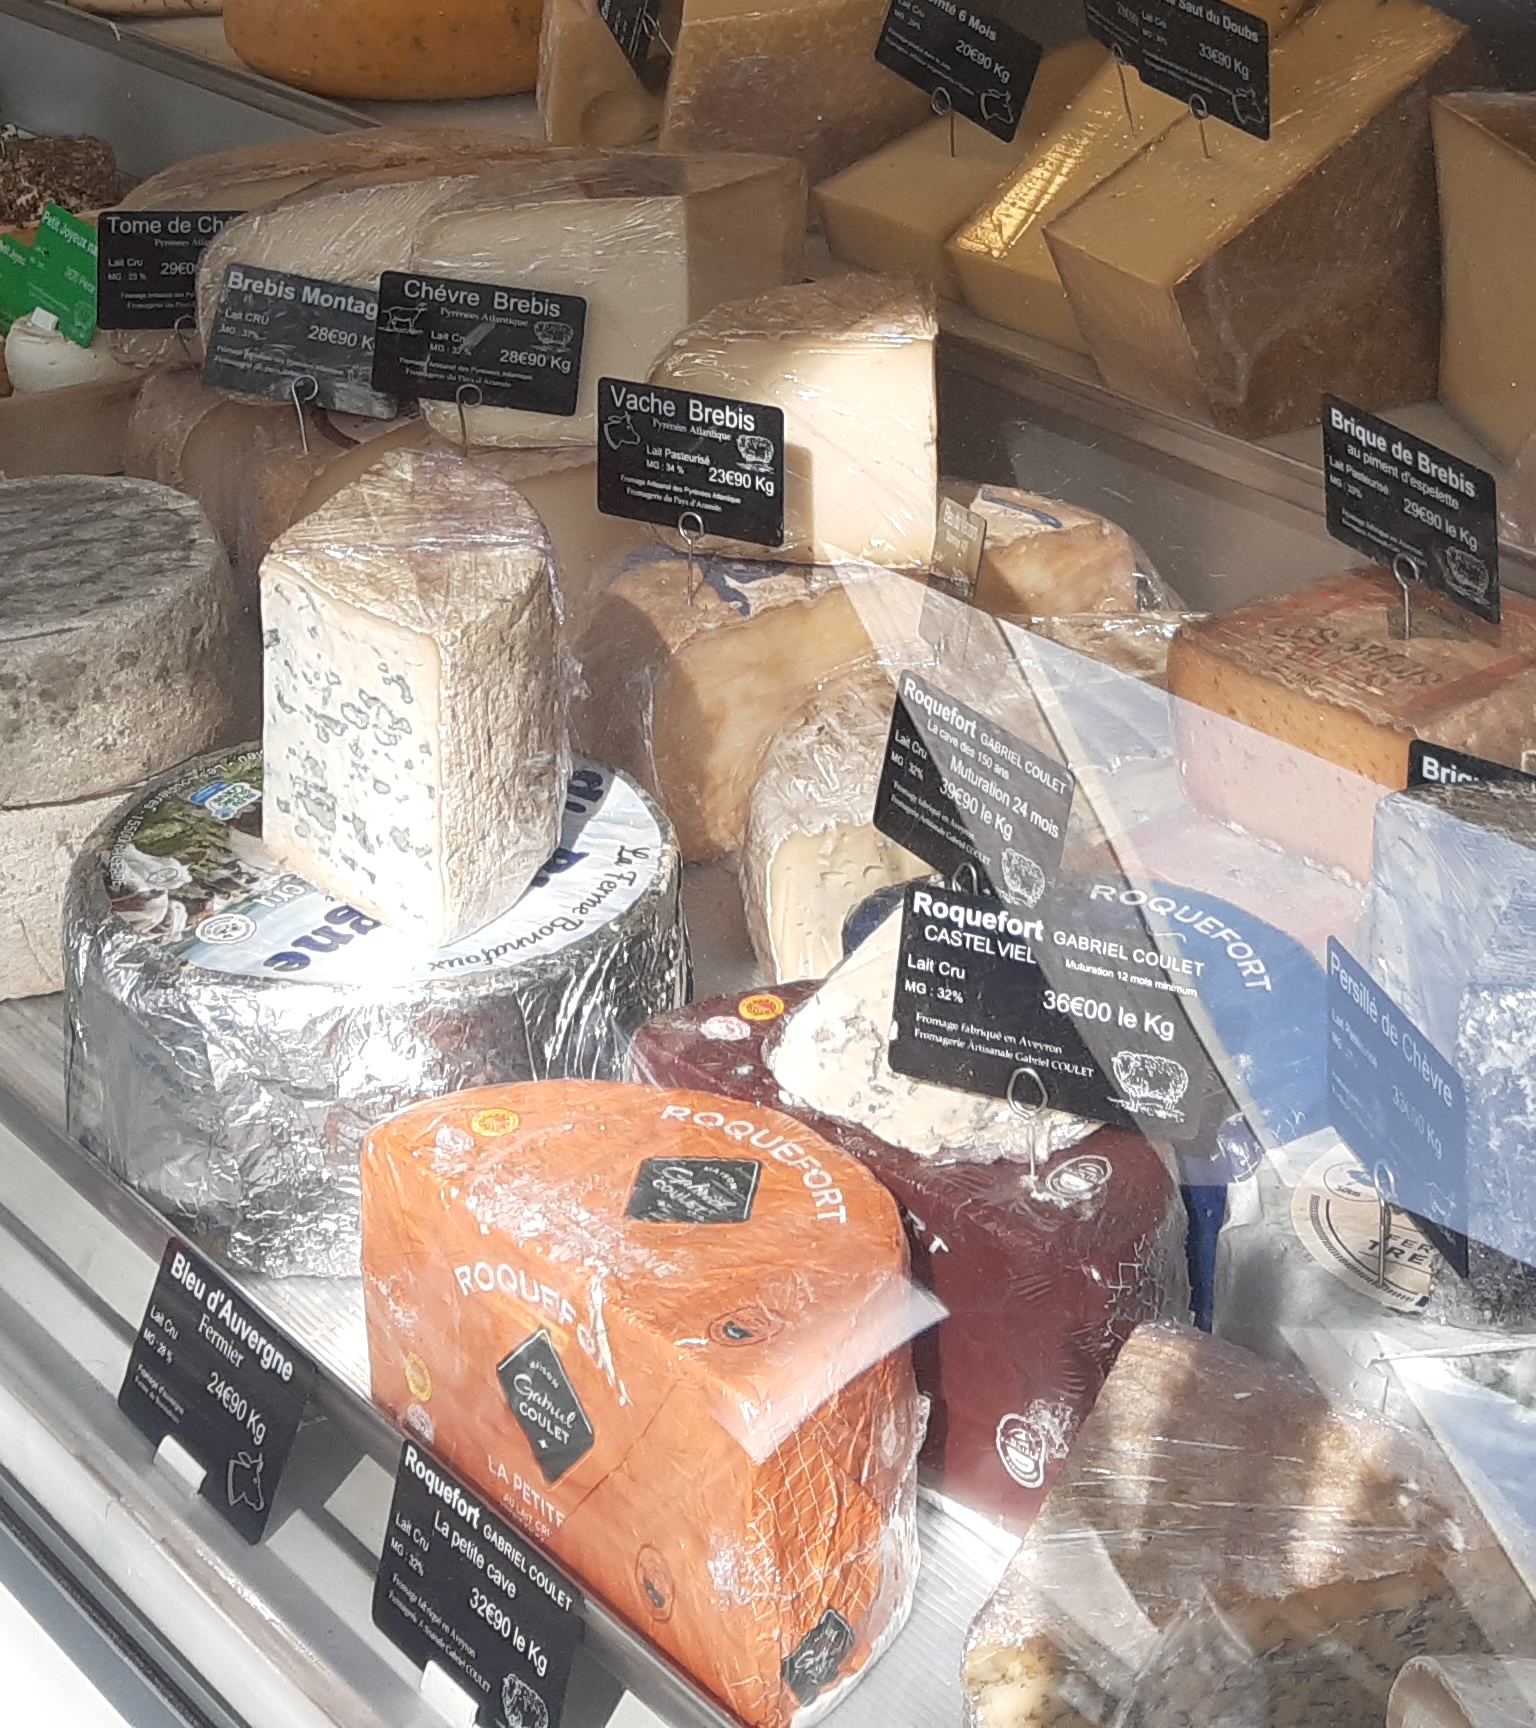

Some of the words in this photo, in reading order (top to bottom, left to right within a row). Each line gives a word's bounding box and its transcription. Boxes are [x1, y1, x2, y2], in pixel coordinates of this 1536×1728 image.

[959, 9, 967, 23] 6
[968, 18, 997, 42] Mois
[1205, 7, 1221, 25] du
[1221, 12, 1259, 43] Doubs
[955, 39, 993, 71] 20€90
[993, 60, 1011, 84] Kg
[404, 279, 481, 307] Chévre
[493, 291, 561, 318] Brebis
[499, 349, 547, 369] 28€90
[550, 355, 572, 374] Kg
[610, 384, 676, 417] Vache
[689, 399, 756, 432] Brebis
[708, 467, 752, 490] 23€90
[755, 475, 775, 496] Kg
[1331, 407, 1387, 452] Brique
[1392, 441, 1413, 465] de
[1417, 451, 1476, 498] Brebis
[1403, 498, 1442, 529] 29€90
[1445, 519, 1457, 538] le
[1459, 527, 1478, 552] Kg
[904, 678, 978, 739] Roquefort
[980, 733, 1022, 769] GABRIEL
[1025, 761, 1067, 795] COULET
[939, 778, 978, 814] 39€90
[981, 803, 992, 824] le
[995, 813, 1013, 841] Kg
[913, 891, 1045, 941] Roquefort
[1053, 931, 1128, 961] GABRIEL
[1133, 949, 1205, 976] COULET
[1090, 884, 1272, 992] ROQUEFORT
[1043, 990, 1112, 1023] 36€00
[1118, 1006, 1138, 1028] le
[1144, 1012, 1176, 1041] Kg
[661, 1105, 848, 1224] ROQUEFORT
[171, 1252, 207, 1299] Bleu
[207, 1290, 293, 1381] d'Auvergne
[198, 1313, 246, 1368] Fermier
[207, 1372, 247, 1421] 24€90
[247, 1409, 267, 1445] Kg
[405, 1444, 480, 1529] Roquefort
[483, 1524, 527, 1573] GABRIEL
[529, 1565, 573, 1612] COULET
[469, 1587, 512, 1638] 32€90
[514, 1627, 527, 1653] le
[528, 1641, 548, 1677] Kg
